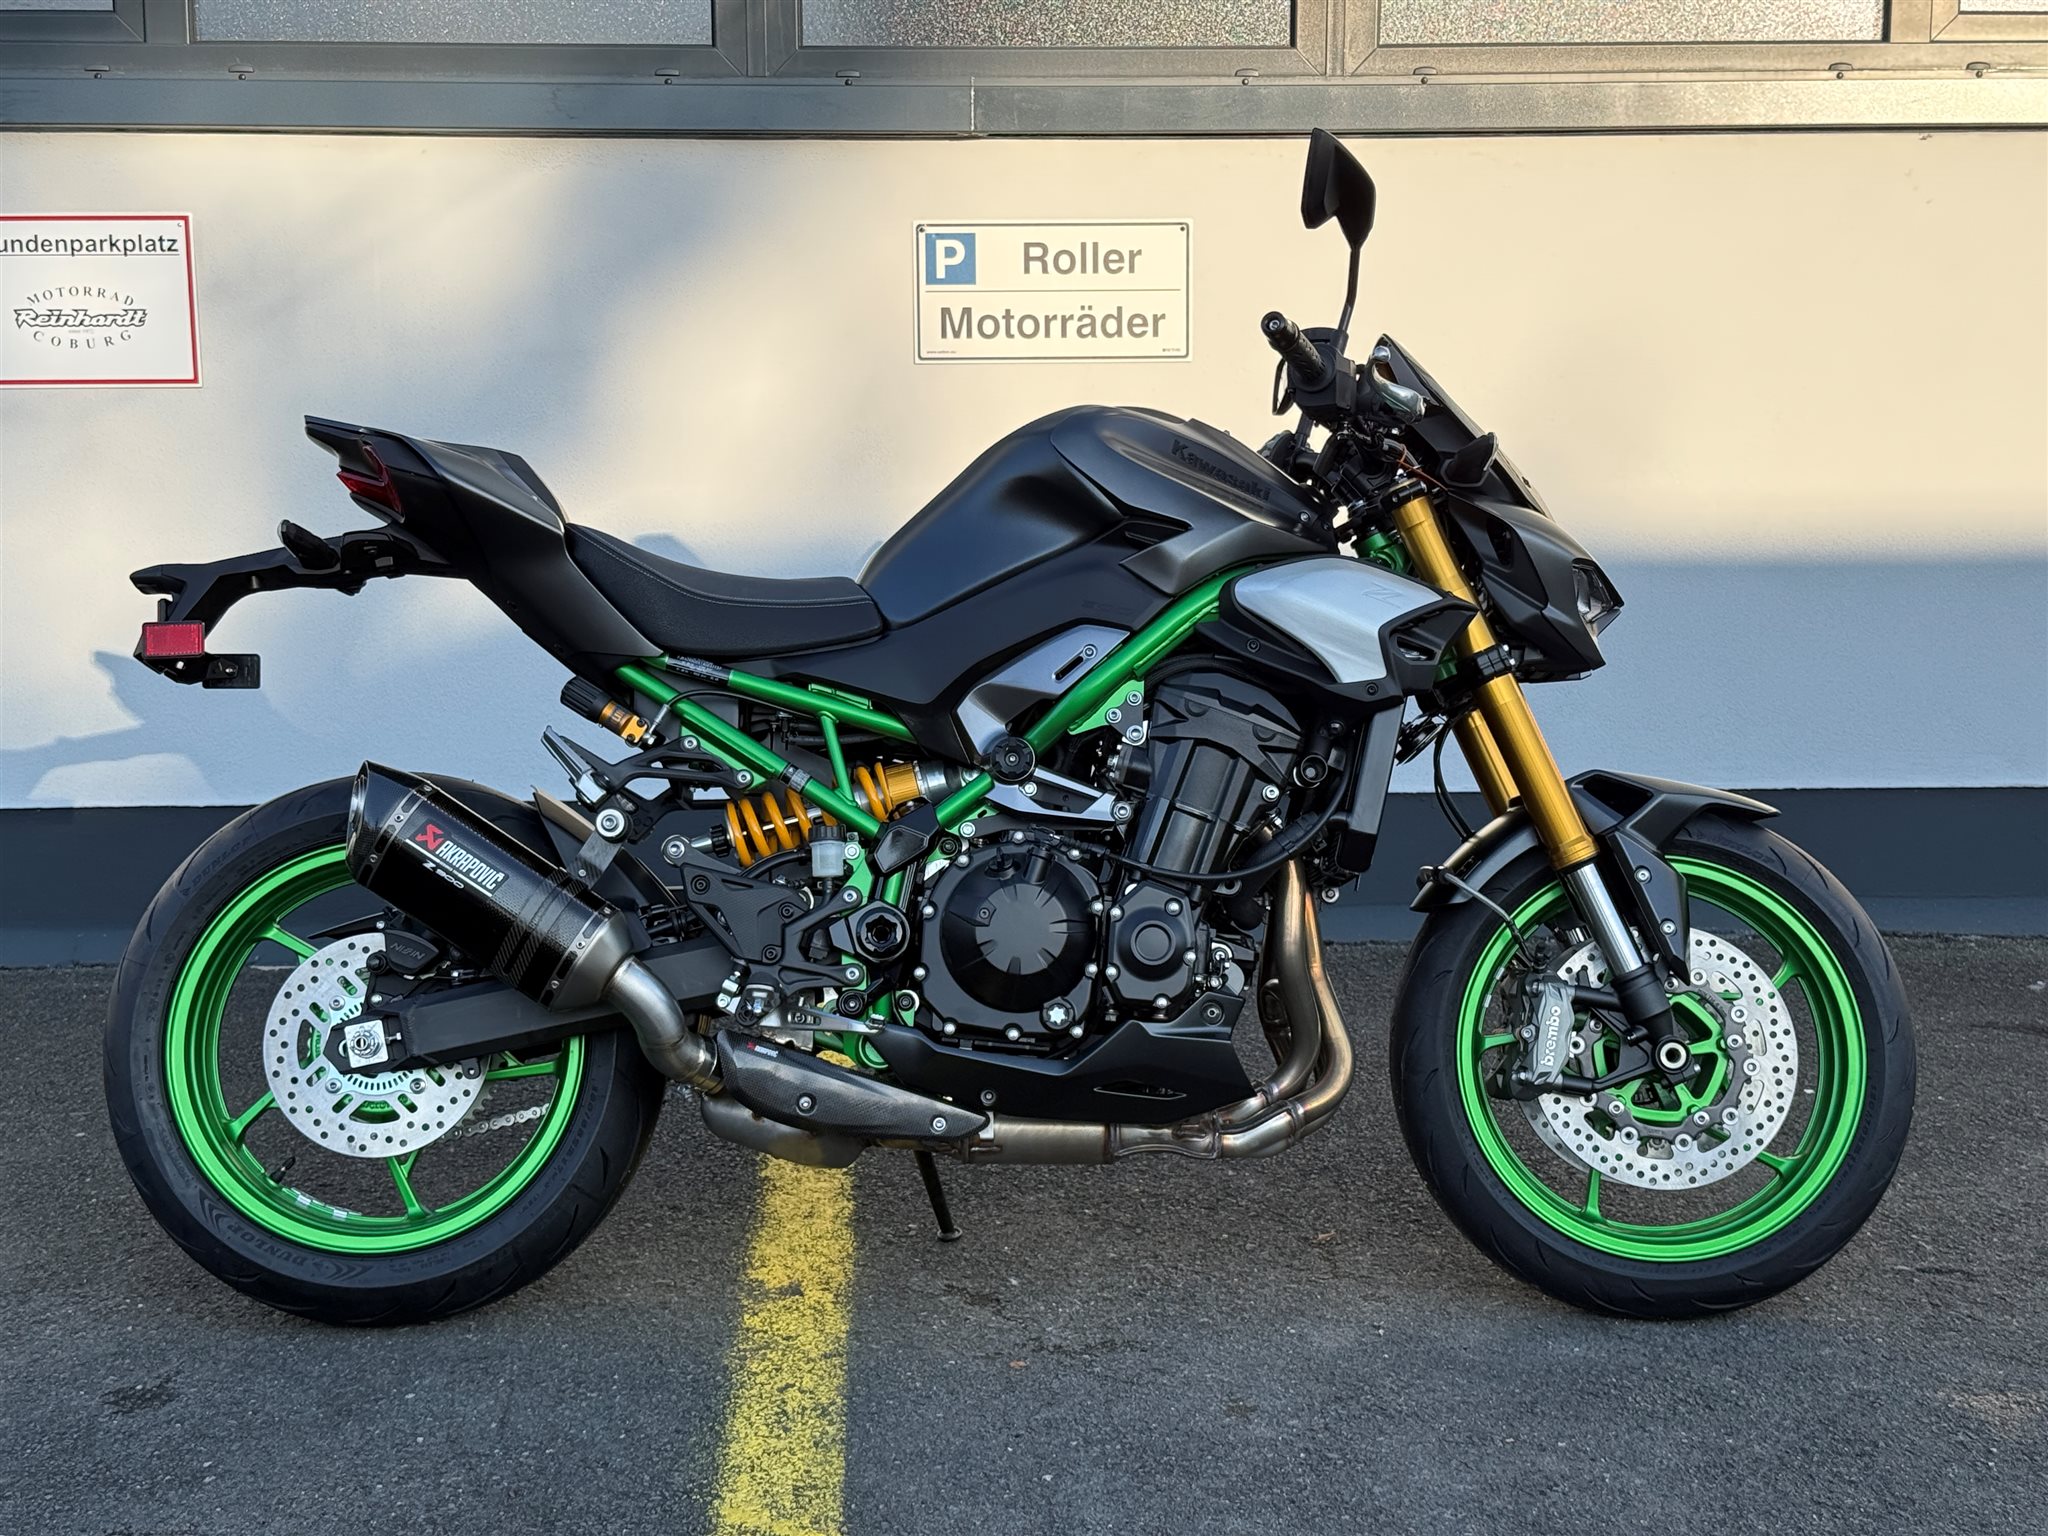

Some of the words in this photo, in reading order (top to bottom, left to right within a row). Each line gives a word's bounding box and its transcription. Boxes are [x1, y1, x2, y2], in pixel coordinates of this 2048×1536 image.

[934, 239, 966, 280] P
[1022, 241, 1143, 275] Roller
[26, 285, 135, 307] MOTORRAD
[13, 308, 148, 329] Reinhardt
[940, 304, 1166, 340] Motorräder
[33, 329, 132, 350] COBURG
[1171, 439, 1272, 501] Kawasaki
[1541, 1005, 1561, 1066] brembo
[227, 1222, 308, 1267] DUNLOP
